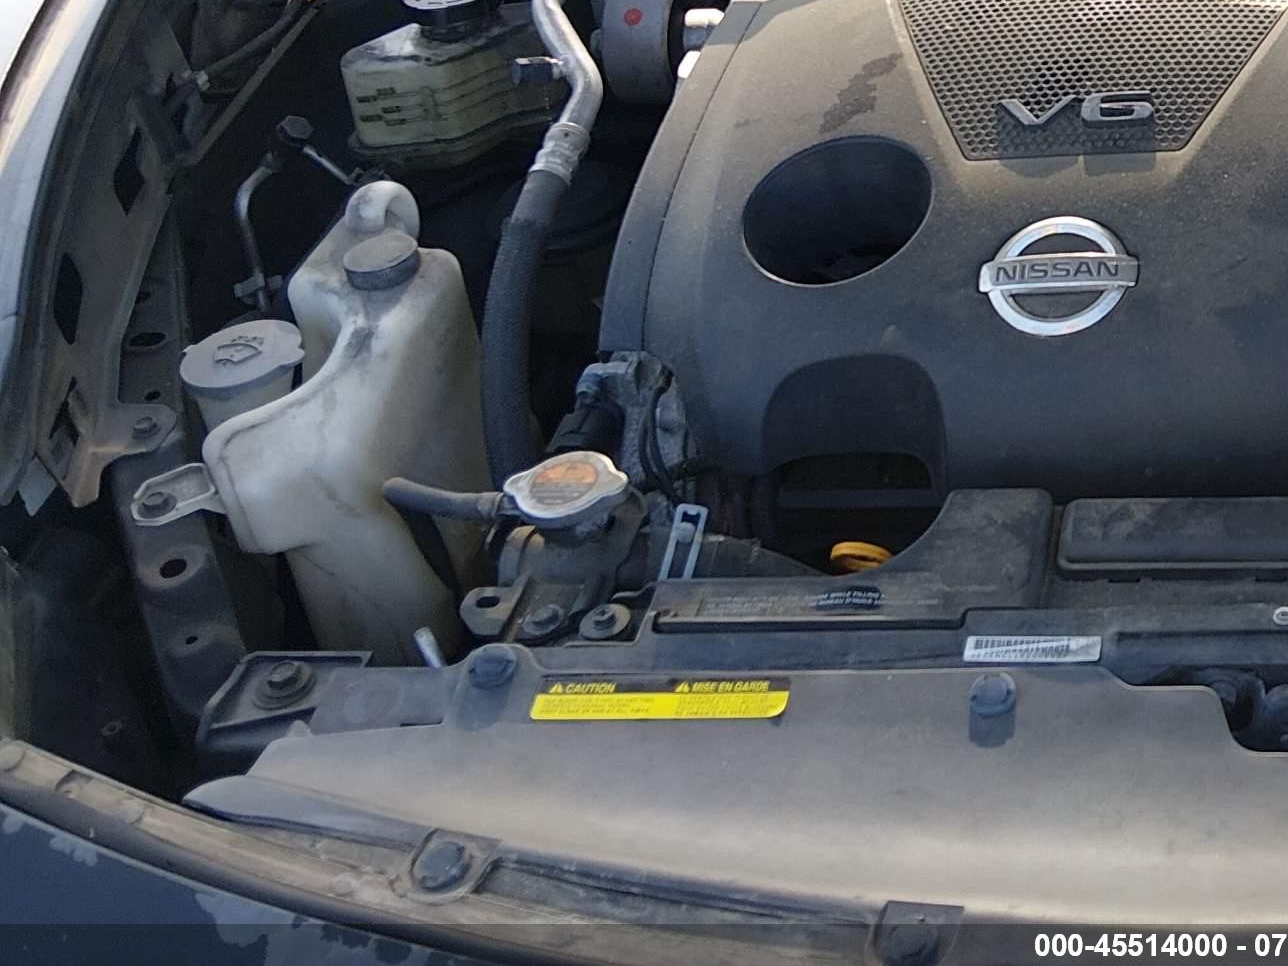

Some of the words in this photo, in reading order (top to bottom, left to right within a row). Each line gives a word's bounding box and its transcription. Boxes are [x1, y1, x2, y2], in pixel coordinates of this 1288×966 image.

[997, 90, 1155, 127] V6
[995, 262, 1120, 283] NISSAN
[565, 682, 617, 693] CAUTION
[691, 681, 715, 693] MISE
[717, 681, 733, 693] EN
